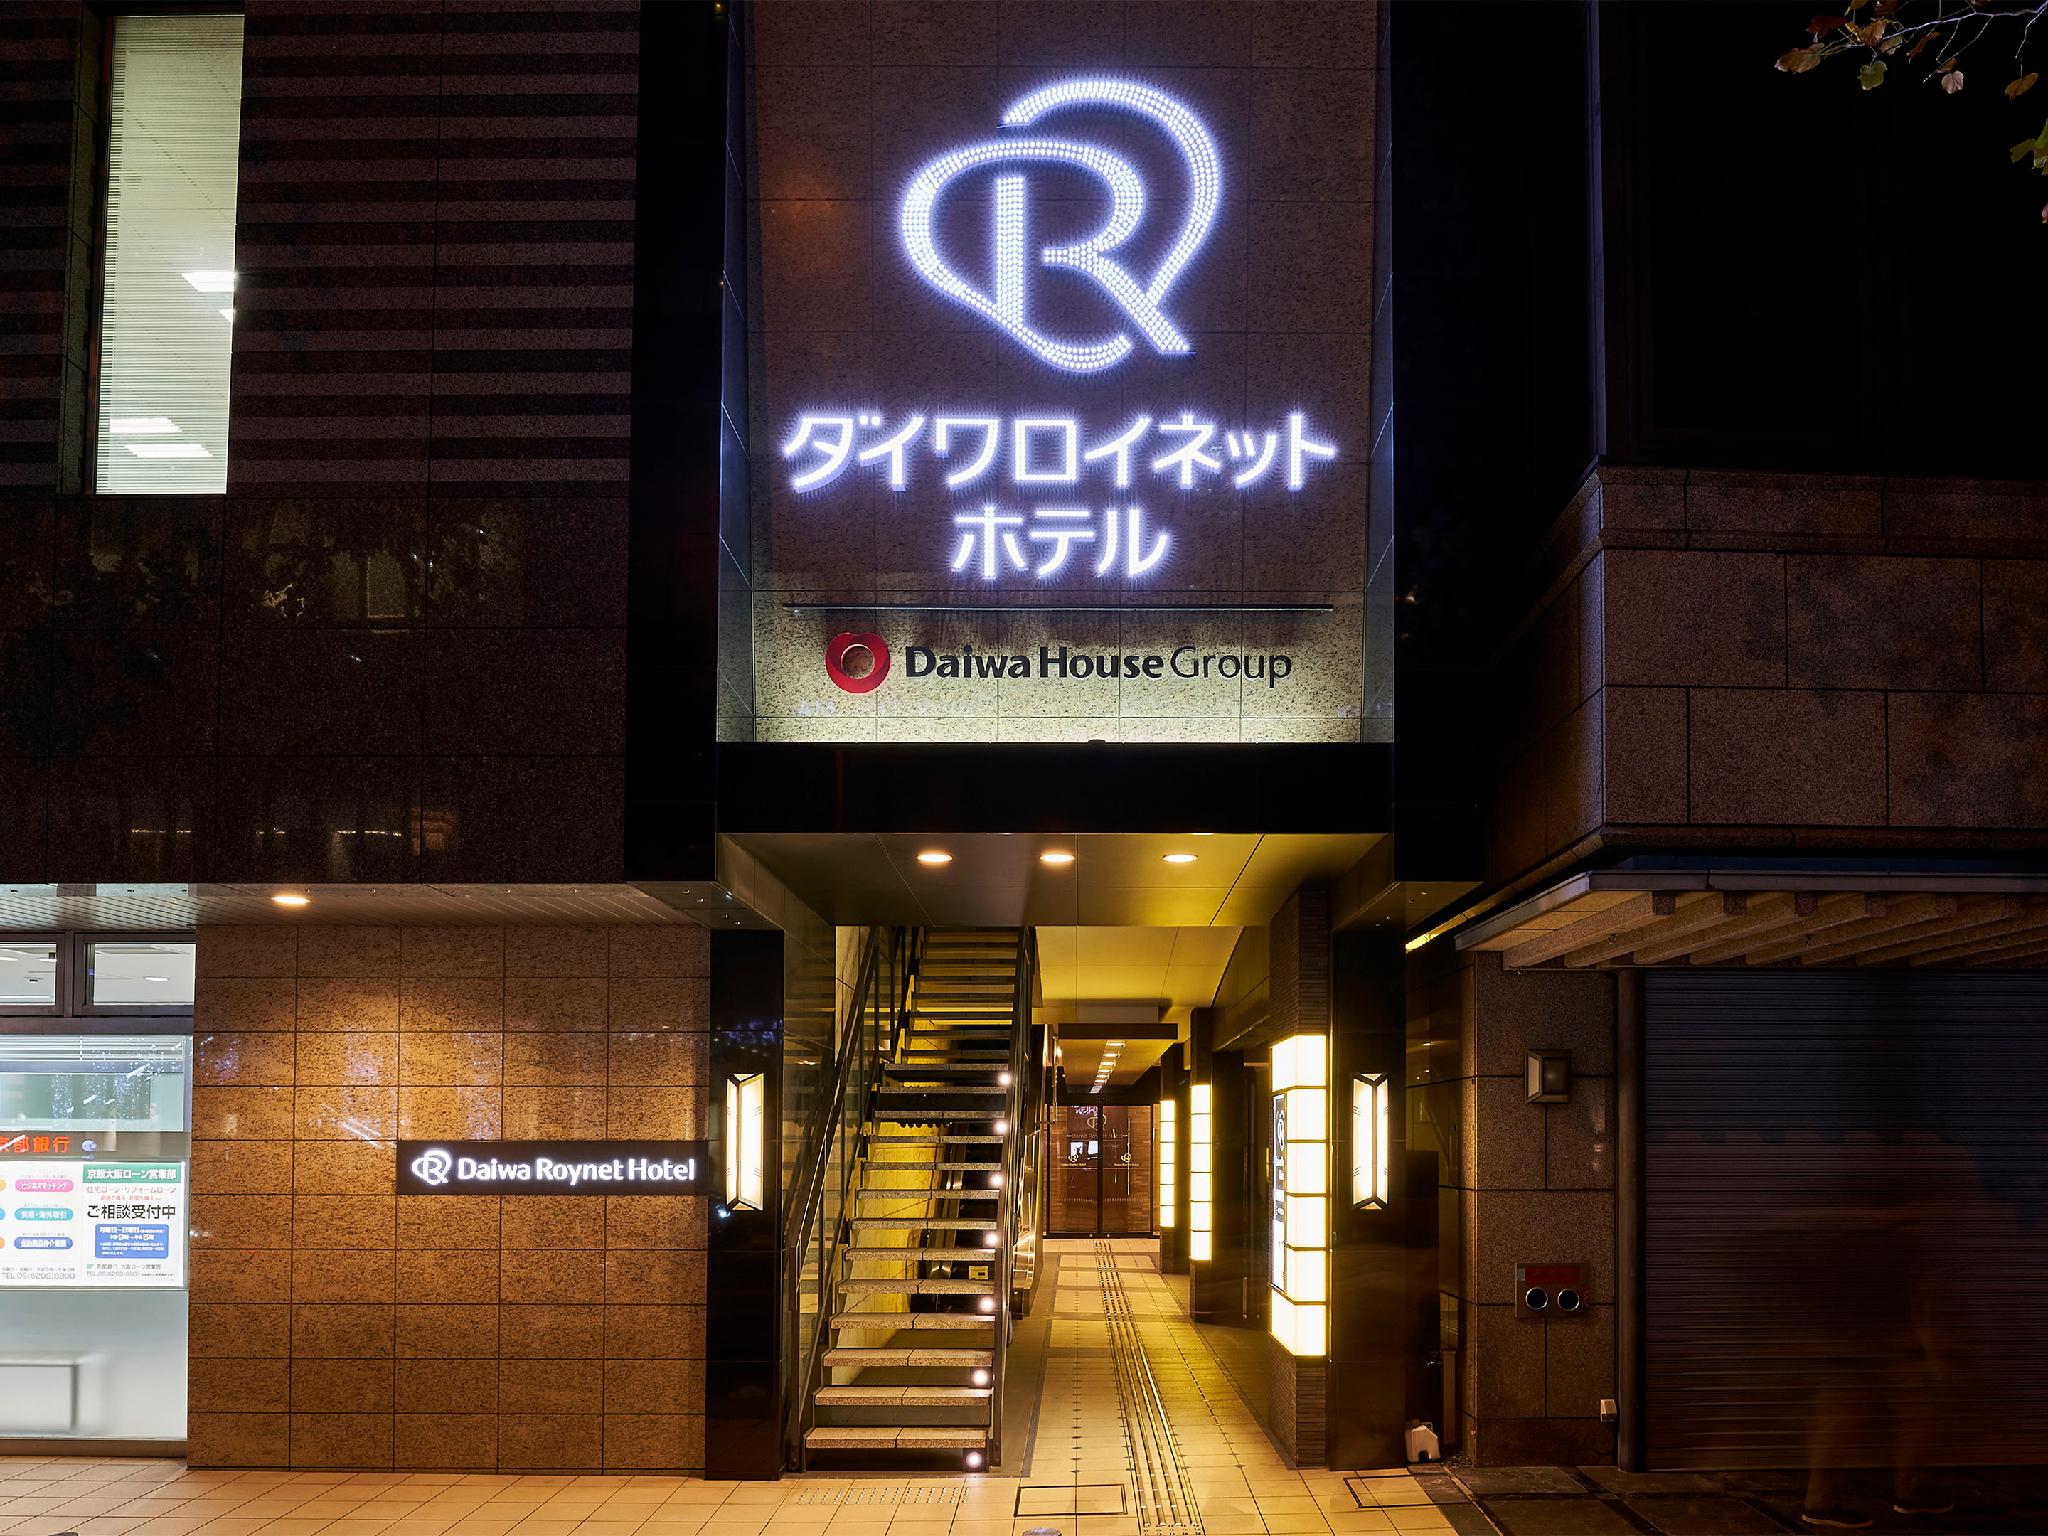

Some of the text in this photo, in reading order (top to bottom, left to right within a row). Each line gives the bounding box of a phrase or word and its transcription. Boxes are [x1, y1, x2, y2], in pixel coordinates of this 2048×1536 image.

[783, 413, 1337, 492] ダイワロイネット
[951, 506, 1170, 580] ホテル
[905, 646, 1292, 688] Daiwa House Group
[458, 1158, 696, 1186] Daiwa Roynet Hotel
[87, 1204, 177, 1220] ご相談受付中
